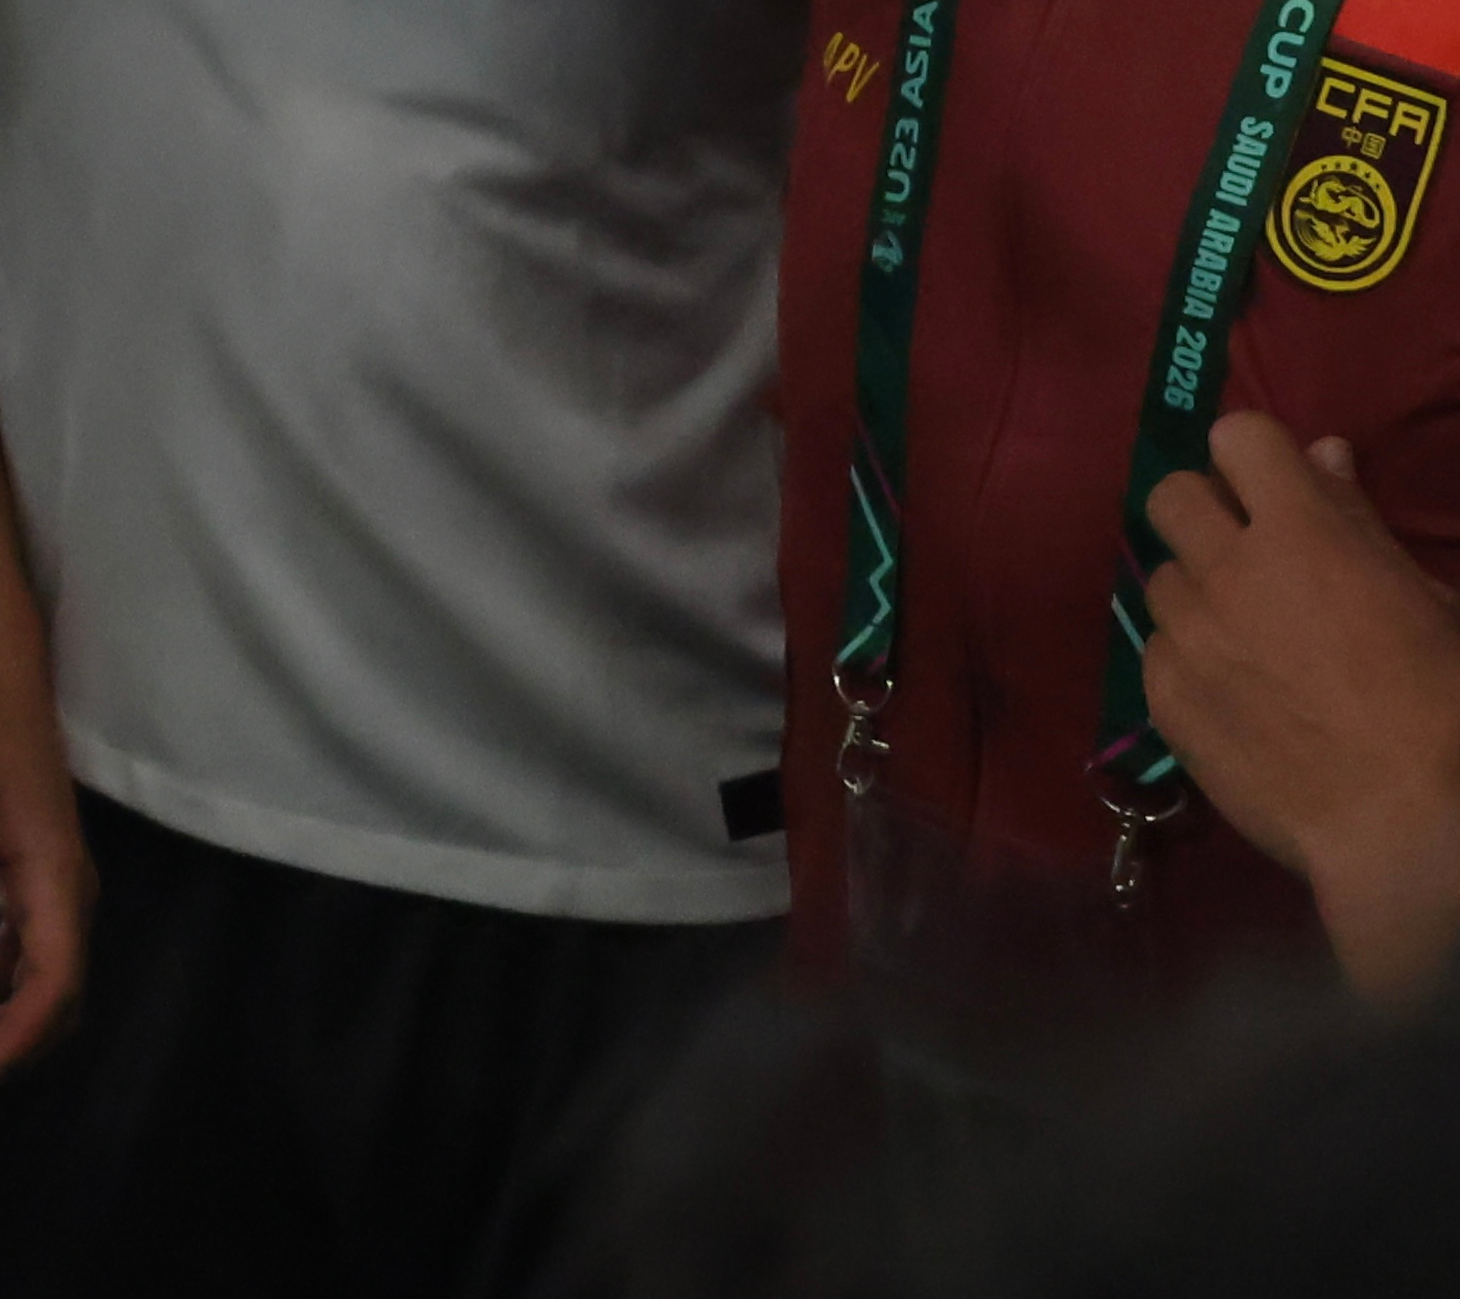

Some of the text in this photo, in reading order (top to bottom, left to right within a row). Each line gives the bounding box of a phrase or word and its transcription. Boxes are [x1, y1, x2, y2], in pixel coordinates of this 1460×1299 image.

[1315, 76, 1431, 146] CFA
[1341, 125, 1387, 161] 中国
[884, 117, 920, 203] U23
[1163, 115, 1275, 412] SAUDI ARABIA 2026
